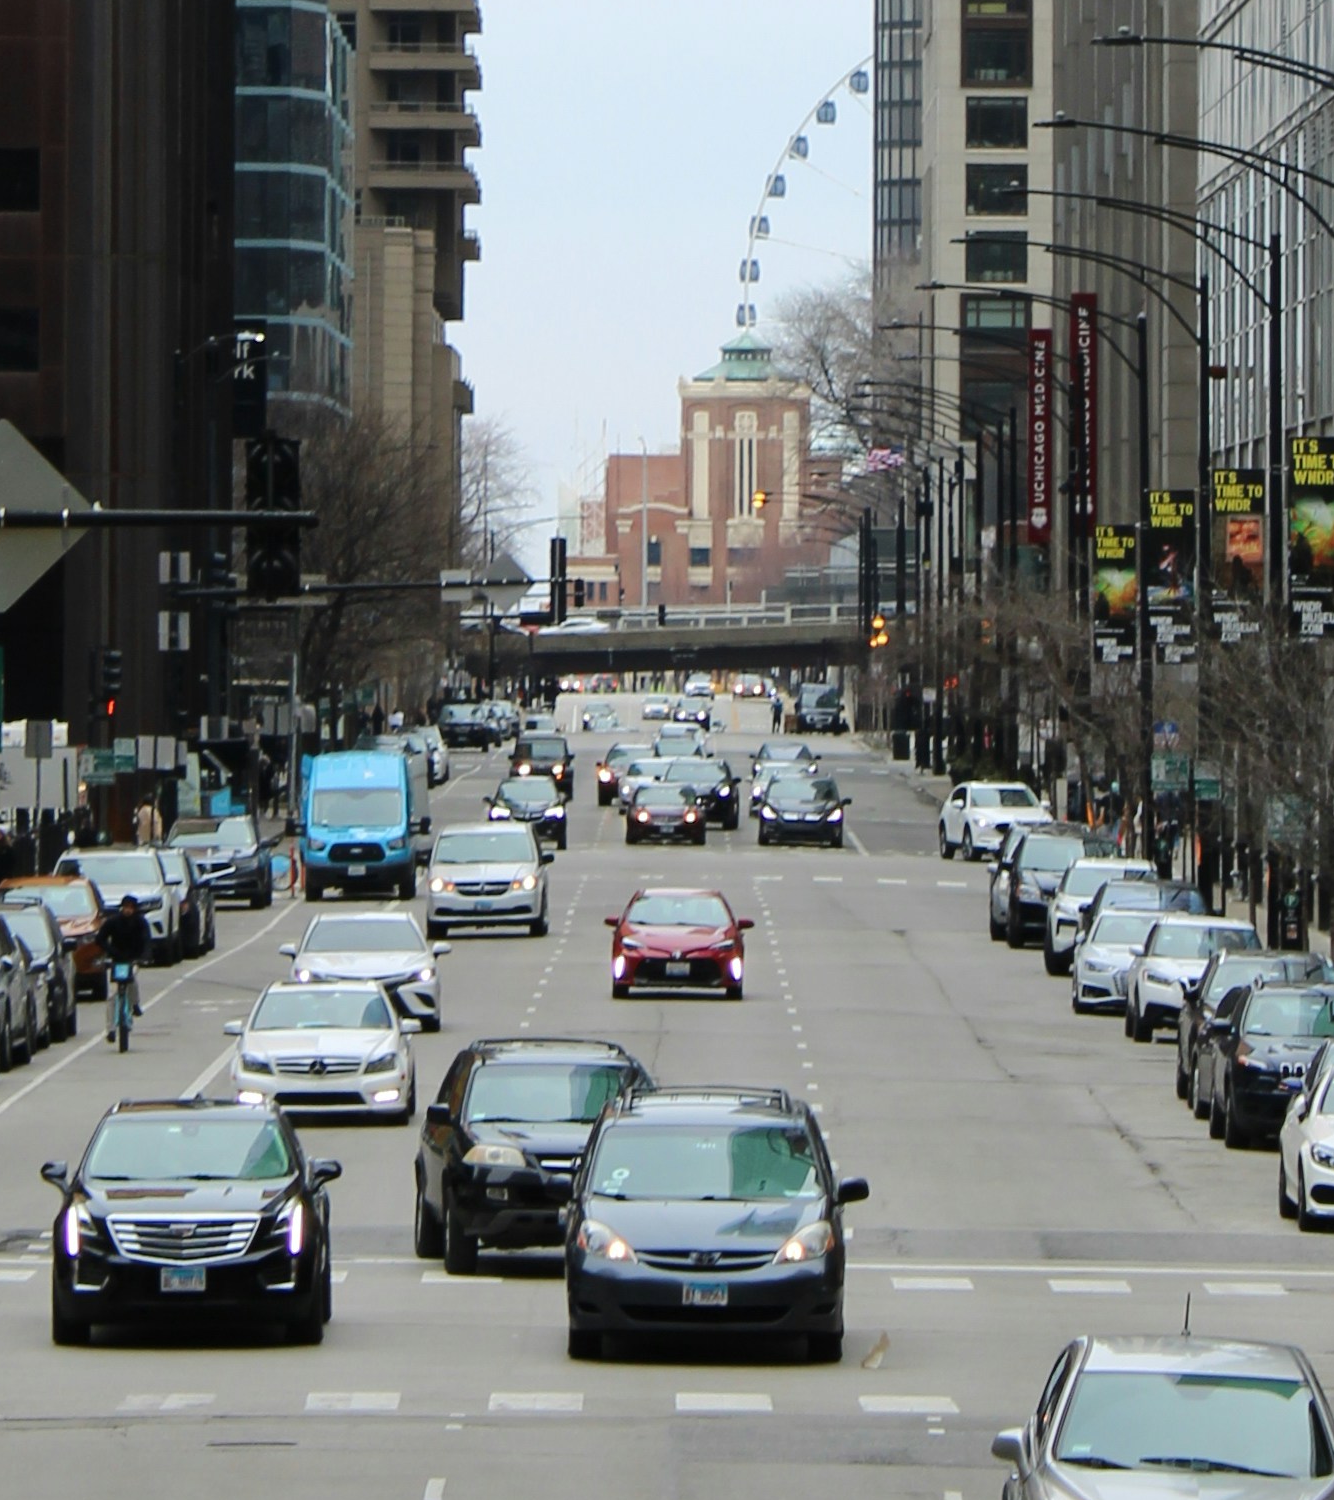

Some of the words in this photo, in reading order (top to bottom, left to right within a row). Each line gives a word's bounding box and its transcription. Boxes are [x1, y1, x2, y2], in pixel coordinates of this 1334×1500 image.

[1293, 439, 1319, 454] IT'S
[1294, 455, 1327, 469] TIME
[1294, 470, 1334, 485] WNDR
[1215, 485, 1244, 498] TIME
[1247, 485, 1263, 498] TO
[1215, 498, 1251, 512] WNDR
